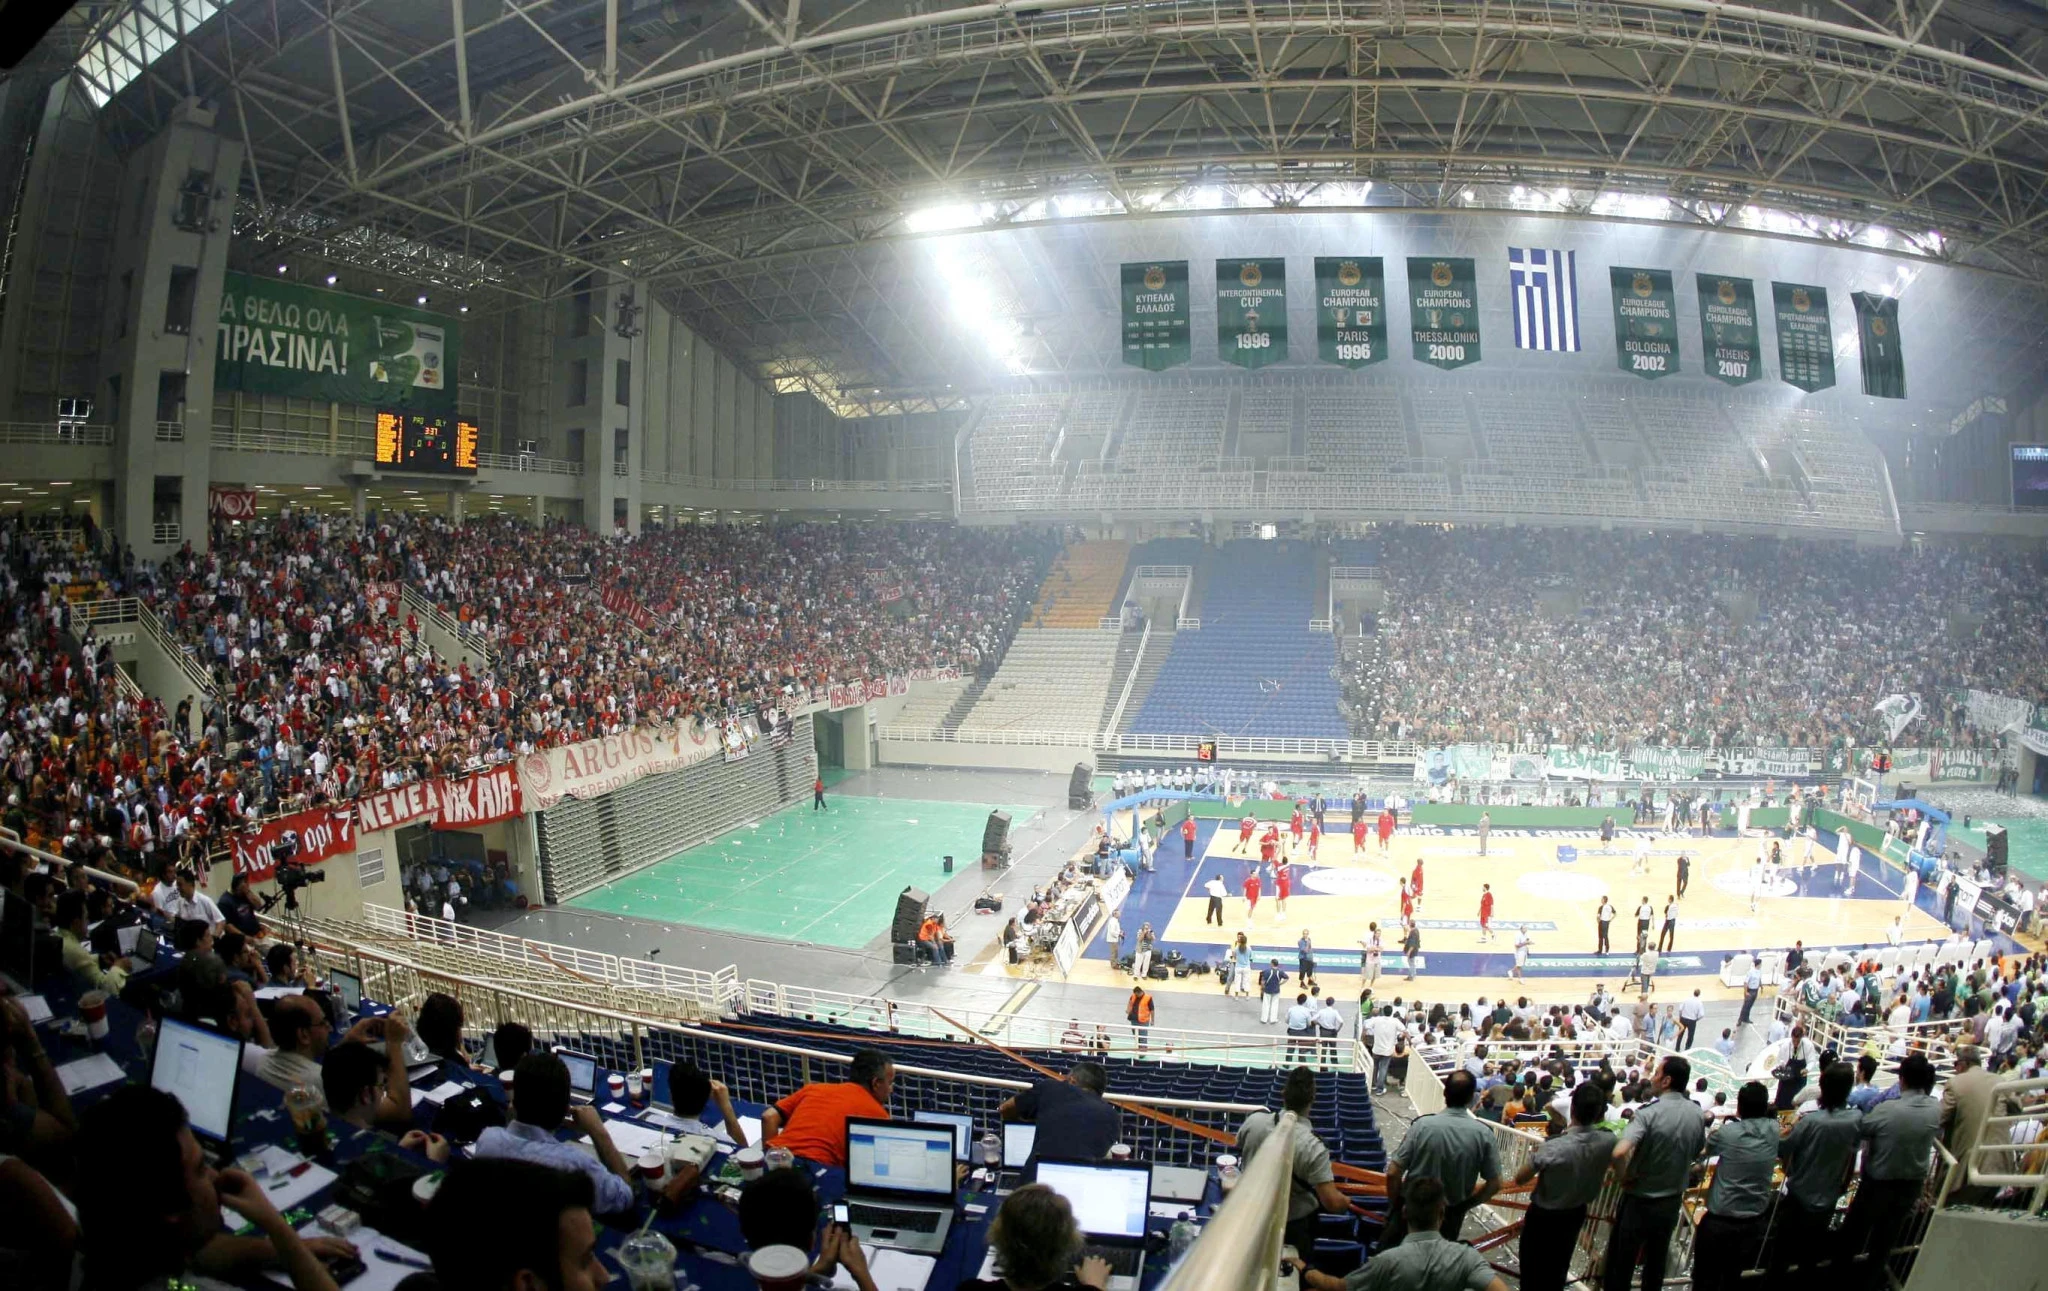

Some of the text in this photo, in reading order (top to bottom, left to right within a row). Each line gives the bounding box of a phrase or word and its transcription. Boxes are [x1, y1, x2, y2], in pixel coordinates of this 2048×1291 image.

[1219, 288, 1284, 298] INTERCONTINENTAL
[1331, 288, 1371, 297] EUROPEAN
[1424, 289, 1463, 298] EUROPEAN
[1136, 304, 1176, 314] ΕΛΛΑΔΟΣ
[1240, 297, 1263, 308] CUP
[1323, 297, 1379, 308] CHAMPIONS
[1416, 298, 1472, 309] CHAMPIONS
[1622, 297, 1666, 308] EUROLEAGUE
[243, 296, 300, 330] ΘΕΛΩ
[306, 307, 349, 338] ΟΛΑ
[1620, 306, 1670, 319] CHAMPIONS
[1706, 314, 1752, 327] CHAMPIONS
[1236, 333, 1270, 349] 1996
[1337, 331, 1369, 342] PARIS
[1414, 331, 1478, 343] THESSALONIKI
[217, 321, 349, 377] ΠΡΑΣΙΝΑ!
[1336, 344, 1371, 360] 1996
[1429, 344, 1465, 361] 2000
[1625, 341, 1671, 354] BOLOGNA
[1877, 343, 1885, 357] 1
[1715, 348, 1750, 361] ATHENS
[1632, 355, 1666, 371] 2002
[1718, 361, 1748, 378] 2007
[564, 731, 653, 780] ARGOS
[332, 810, 350, 842] 7
